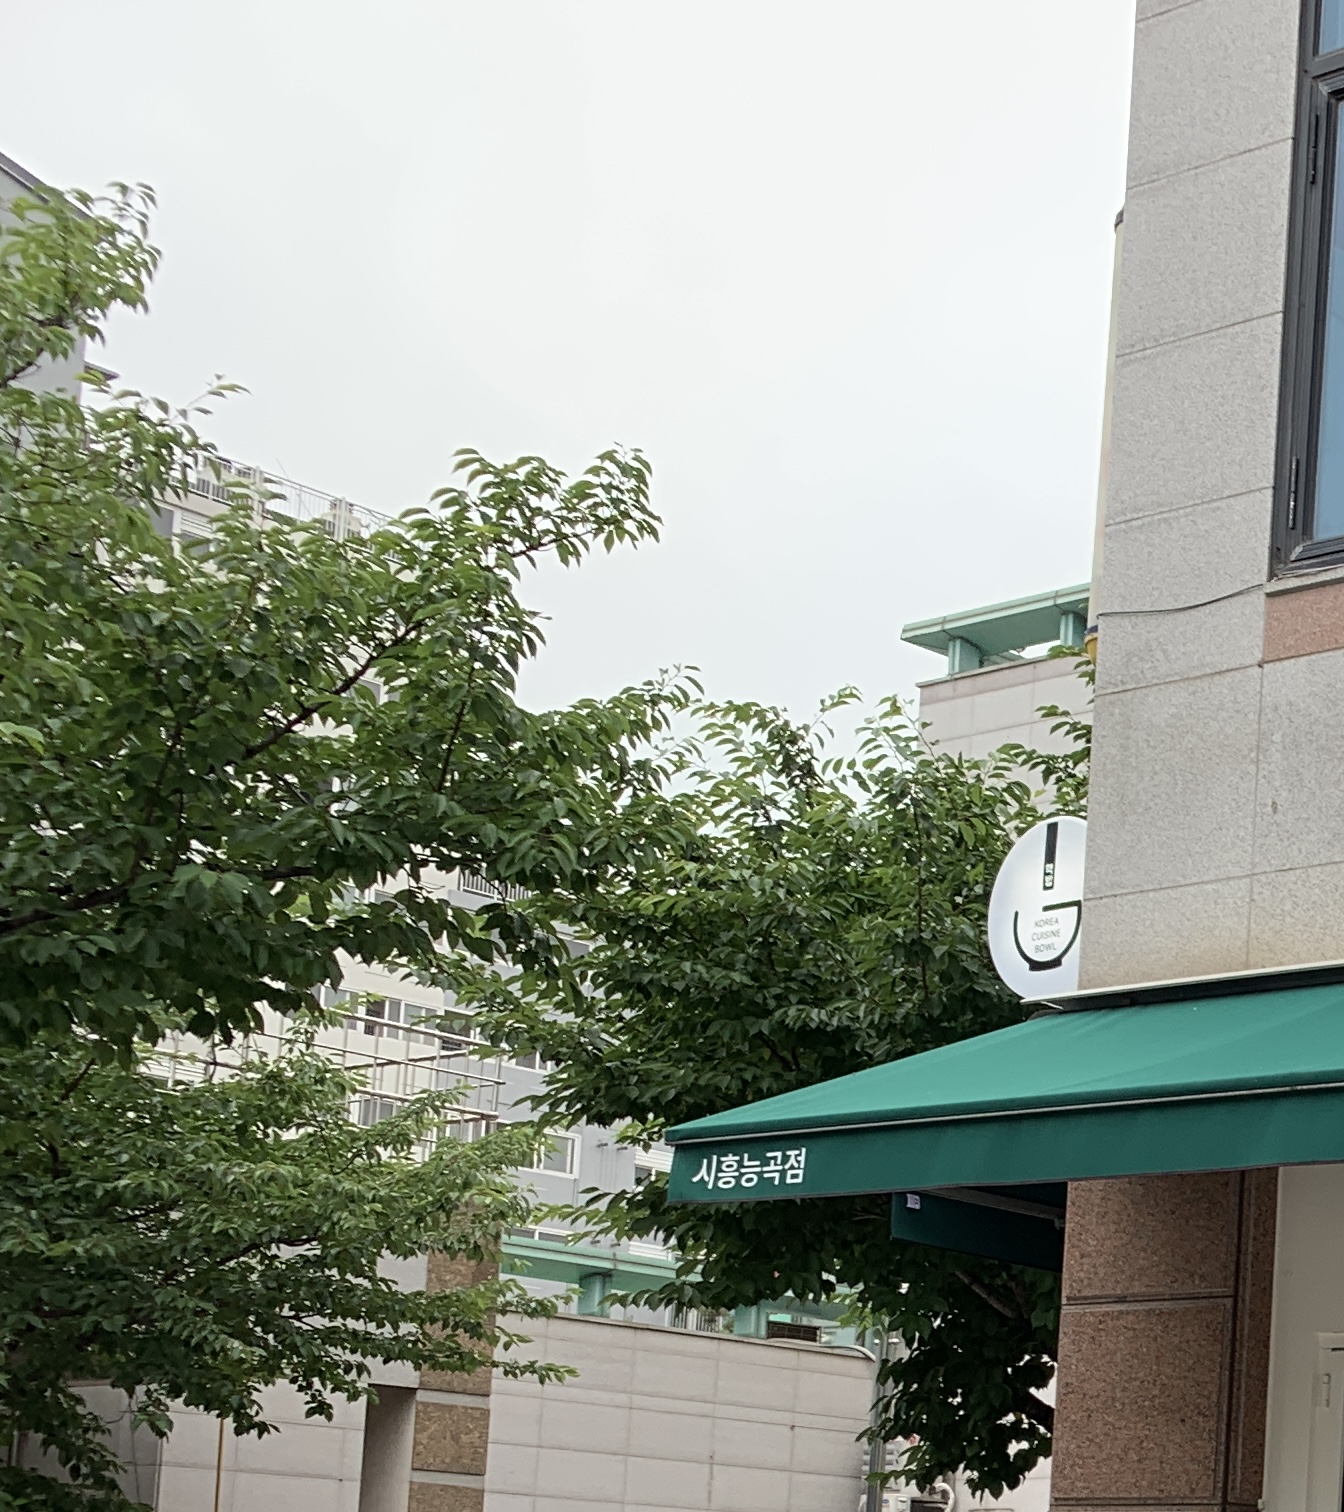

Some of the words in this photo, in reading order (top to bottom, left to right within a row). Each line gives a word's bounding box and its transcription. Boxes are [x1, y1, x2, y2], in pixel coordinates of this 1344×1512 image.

[1034, 917, 1059, 928] KOREA
[1031, 929, 1061, 941] CUISINE
[1034, 943, 1057, 953] BOWL
[691, 1147, 807, 1190] 시흥능곡점
